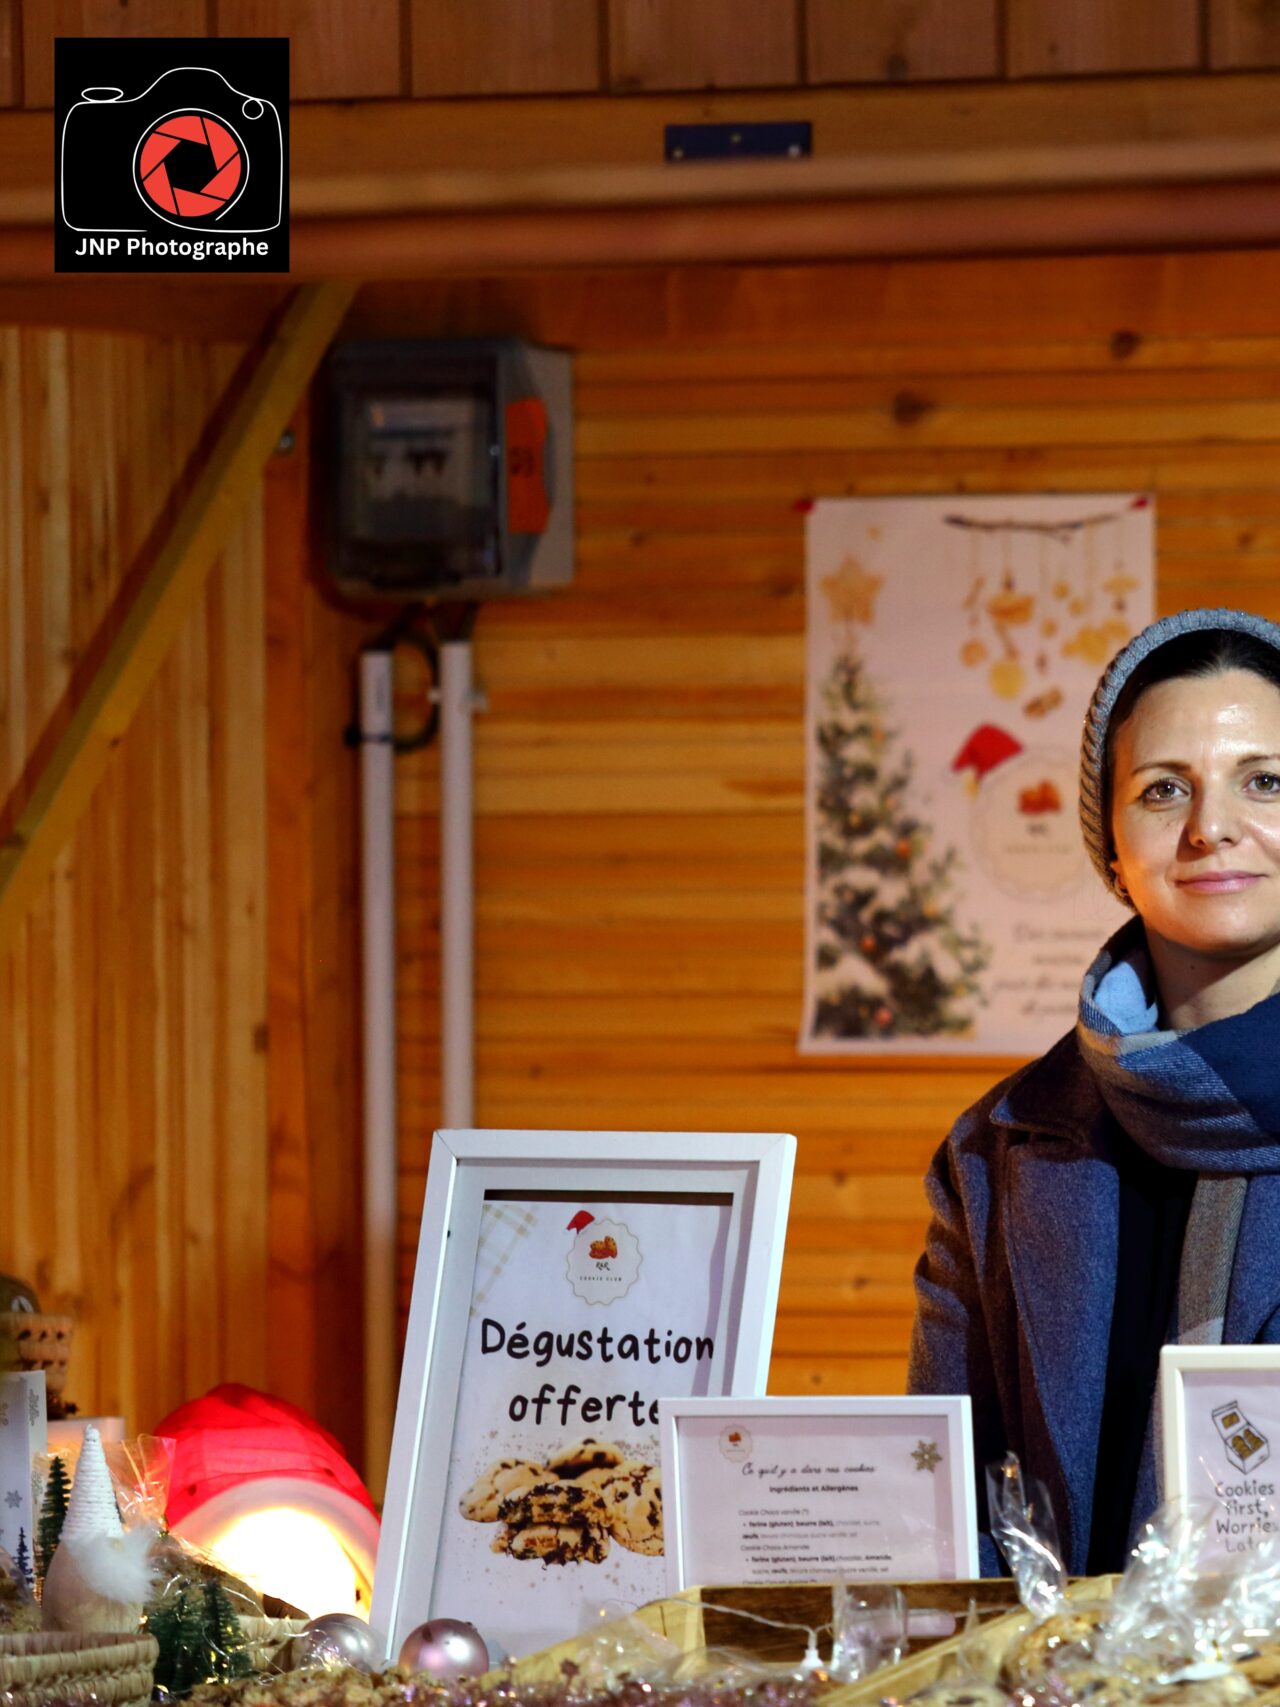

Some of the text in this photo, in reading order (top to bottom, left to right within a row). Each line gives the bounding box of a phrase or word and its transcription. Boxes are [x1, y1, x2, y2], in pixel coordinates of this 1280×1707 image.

[481, 1317, 715, 1368] Dégustation
[1215, 1479, 1275, 1498] Cookies
[1225, 1536, 1260, 1552] Lat
